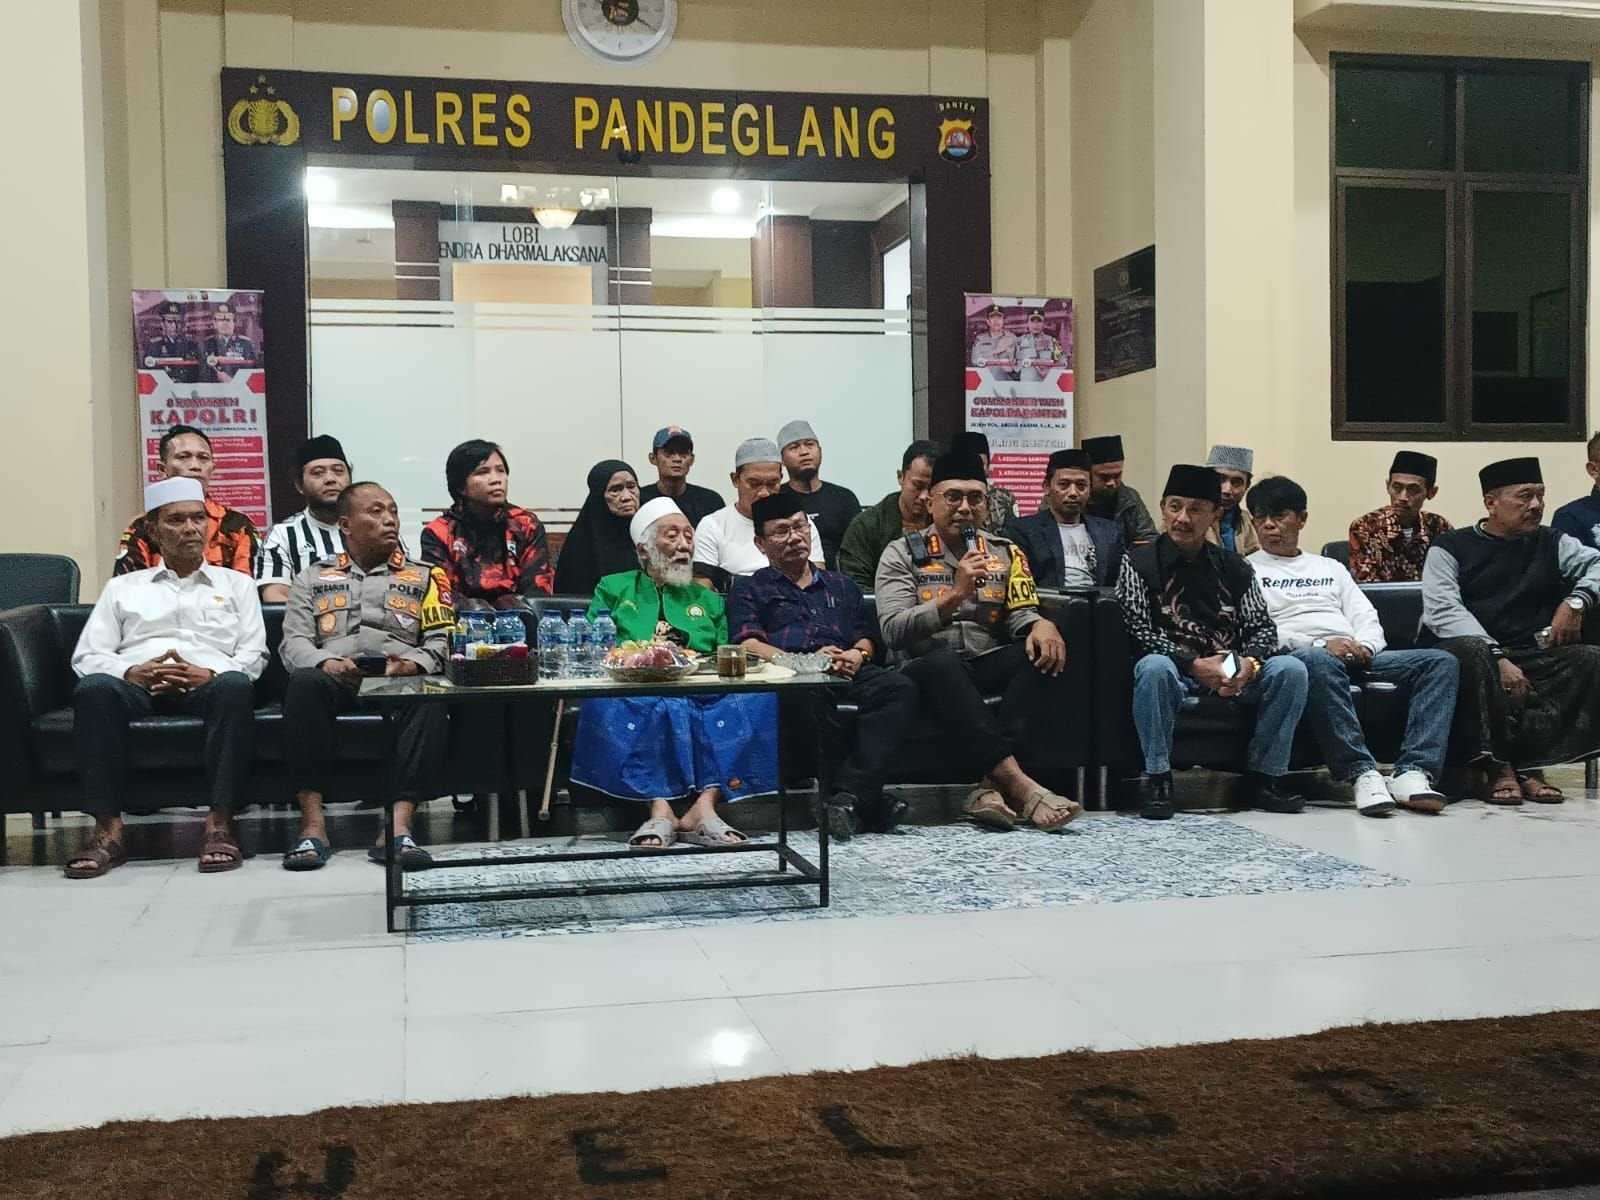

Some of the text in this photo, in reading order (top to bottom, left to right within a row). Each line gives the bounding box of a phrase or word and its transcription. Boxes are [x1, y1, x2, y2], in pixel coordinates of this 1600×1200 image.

[938, 101, 976, 112] BANTEN
[330, 86, 896, 160] POLRES PANDEGLANG
[502, 225, 540, 244] LOBI
[438, 241, 608, 262] ENDRA DHARMALAKSANA
[150, 408, 257, 425] KAPOLRI
[388, 583, 425, 599] POLRI
[1261, 577, 1335, 590] Represent
